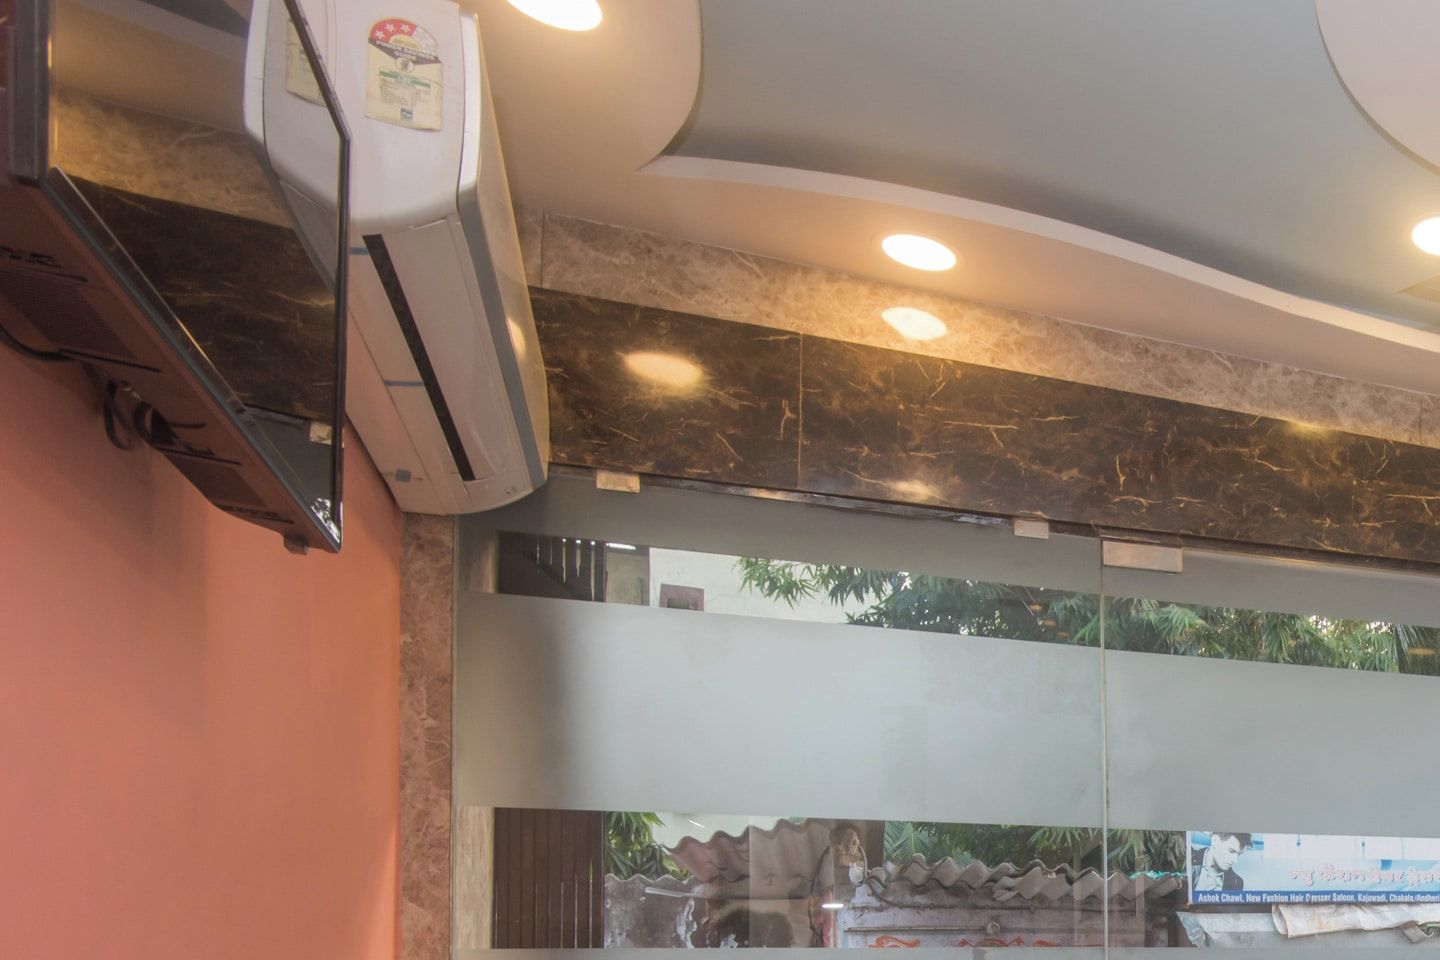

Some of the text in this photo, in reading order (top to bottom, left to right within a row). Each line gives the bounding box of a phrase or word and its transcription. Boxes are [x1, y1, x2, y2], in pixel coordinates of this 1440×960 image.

[1198, 893, 1220, 903] Ashok
[1246, 893, 1261, 902] New
[1262, 893, 1289, 903] Fashion
[1290, 893, 1304, 903] Hair
